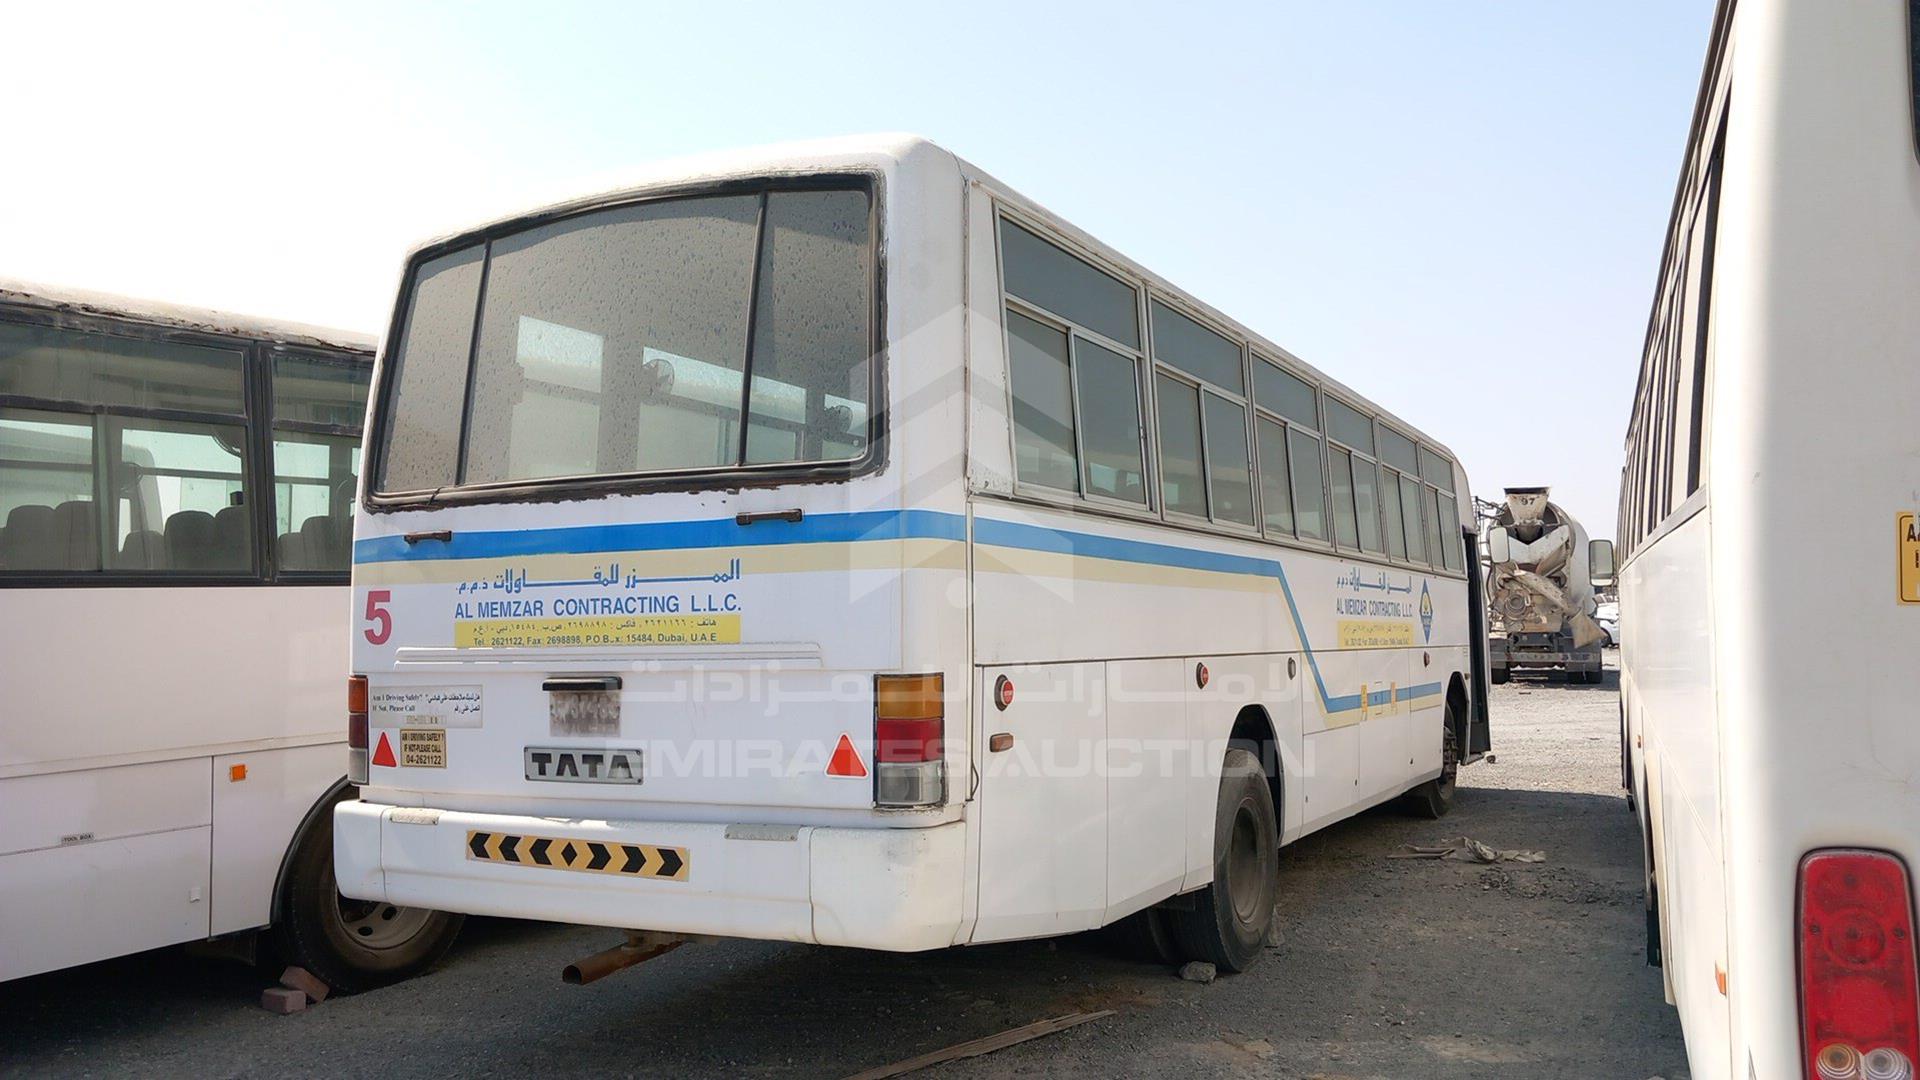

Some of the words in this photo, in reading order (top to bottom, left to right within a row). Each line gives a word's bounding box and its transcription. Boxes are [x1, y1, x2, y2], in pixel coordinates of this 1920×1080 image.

[1521, 497, 1536, 506] 97
[364, 590, 392, 645] 5
[455, 602, 473, 619] AL
[478, 600, 544, 618] MEMZAR
[553, 595, 680, 616] CONTRACTING
[691, 593, 742, 612] L.L.C.
[1345, 599, 1367, 616] MEMZAR
[1368, 600, 1401, 617] CONTRACTING
[531, 752, 634, 779] TATA
